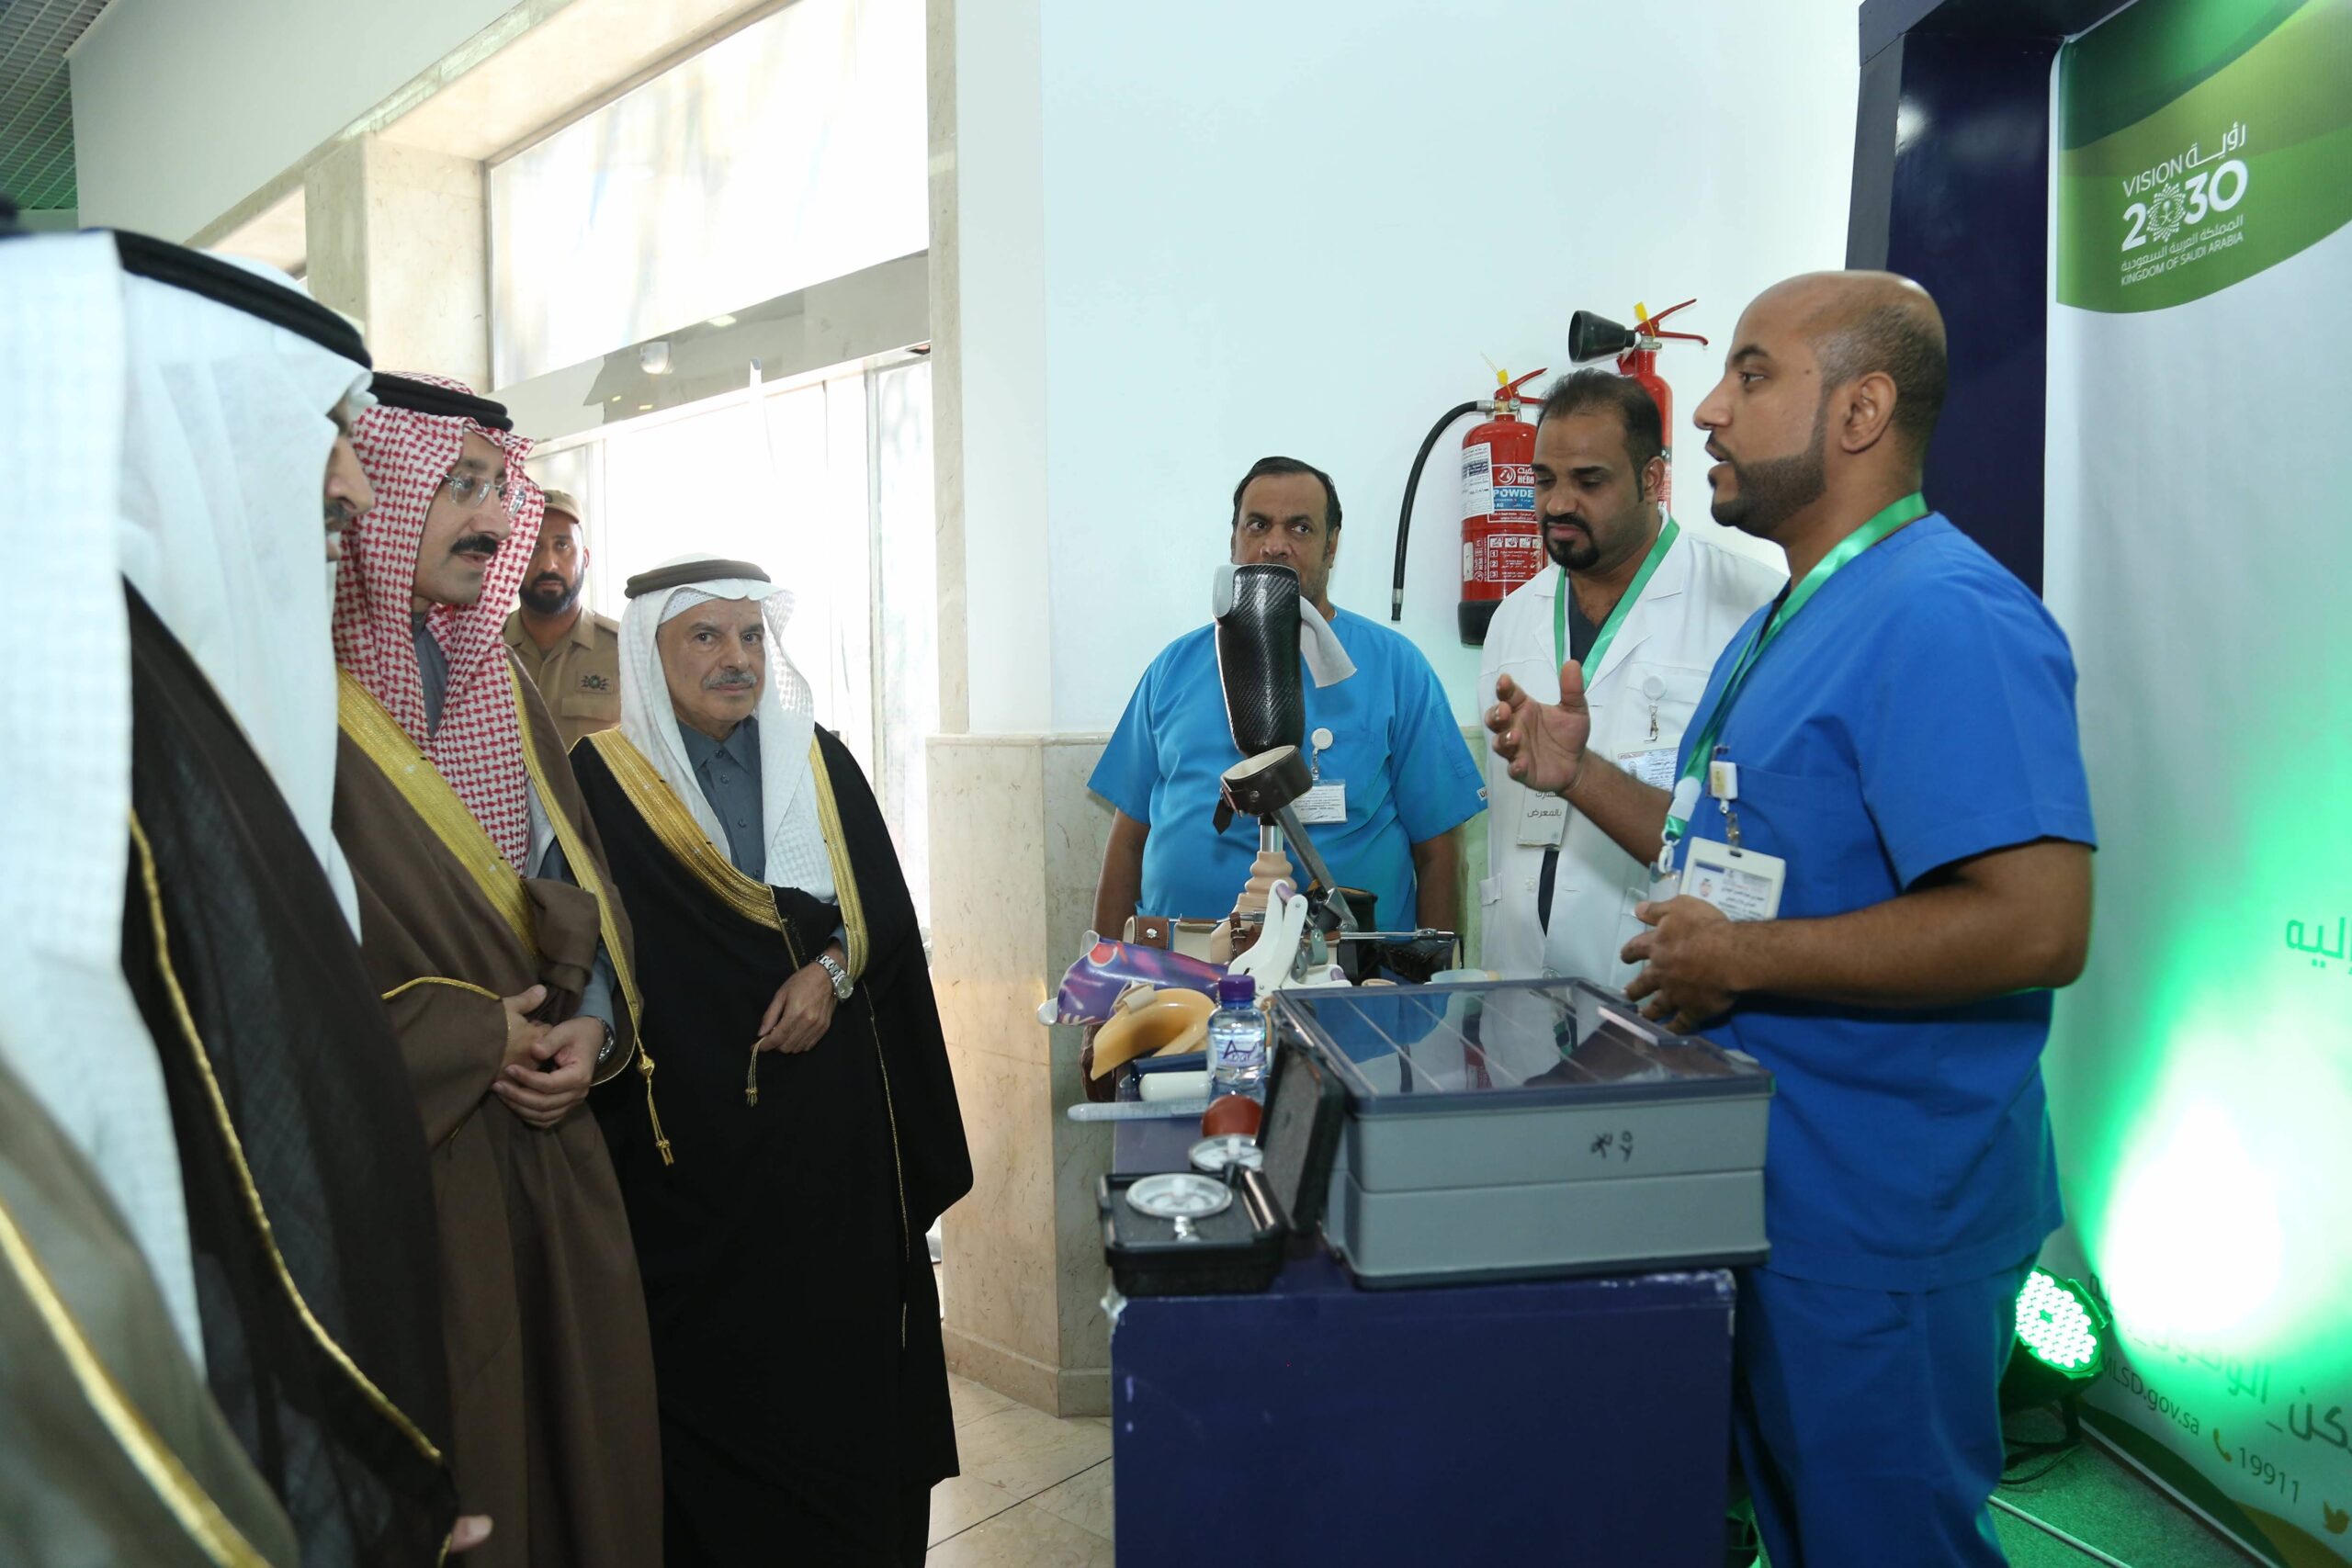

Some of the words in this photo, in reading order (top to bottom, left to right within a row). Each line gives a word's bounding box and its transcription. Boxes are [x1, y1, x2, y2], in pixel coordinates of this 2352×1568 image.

[2122, 155, 2183, 197] VISION
[2199, 214, 2244, 241] المملكة
[2121, 262, 2165, 287] KINGDOM
[2165, 256, 2179, 270] OF
[2179, 245, 2206, 265] SAUDI
[2208, 231, 2244, 254] ARABIA
[1493, 489, 1534, 498] POWDE
[2240, 1448, 2300, 1503] 19911
